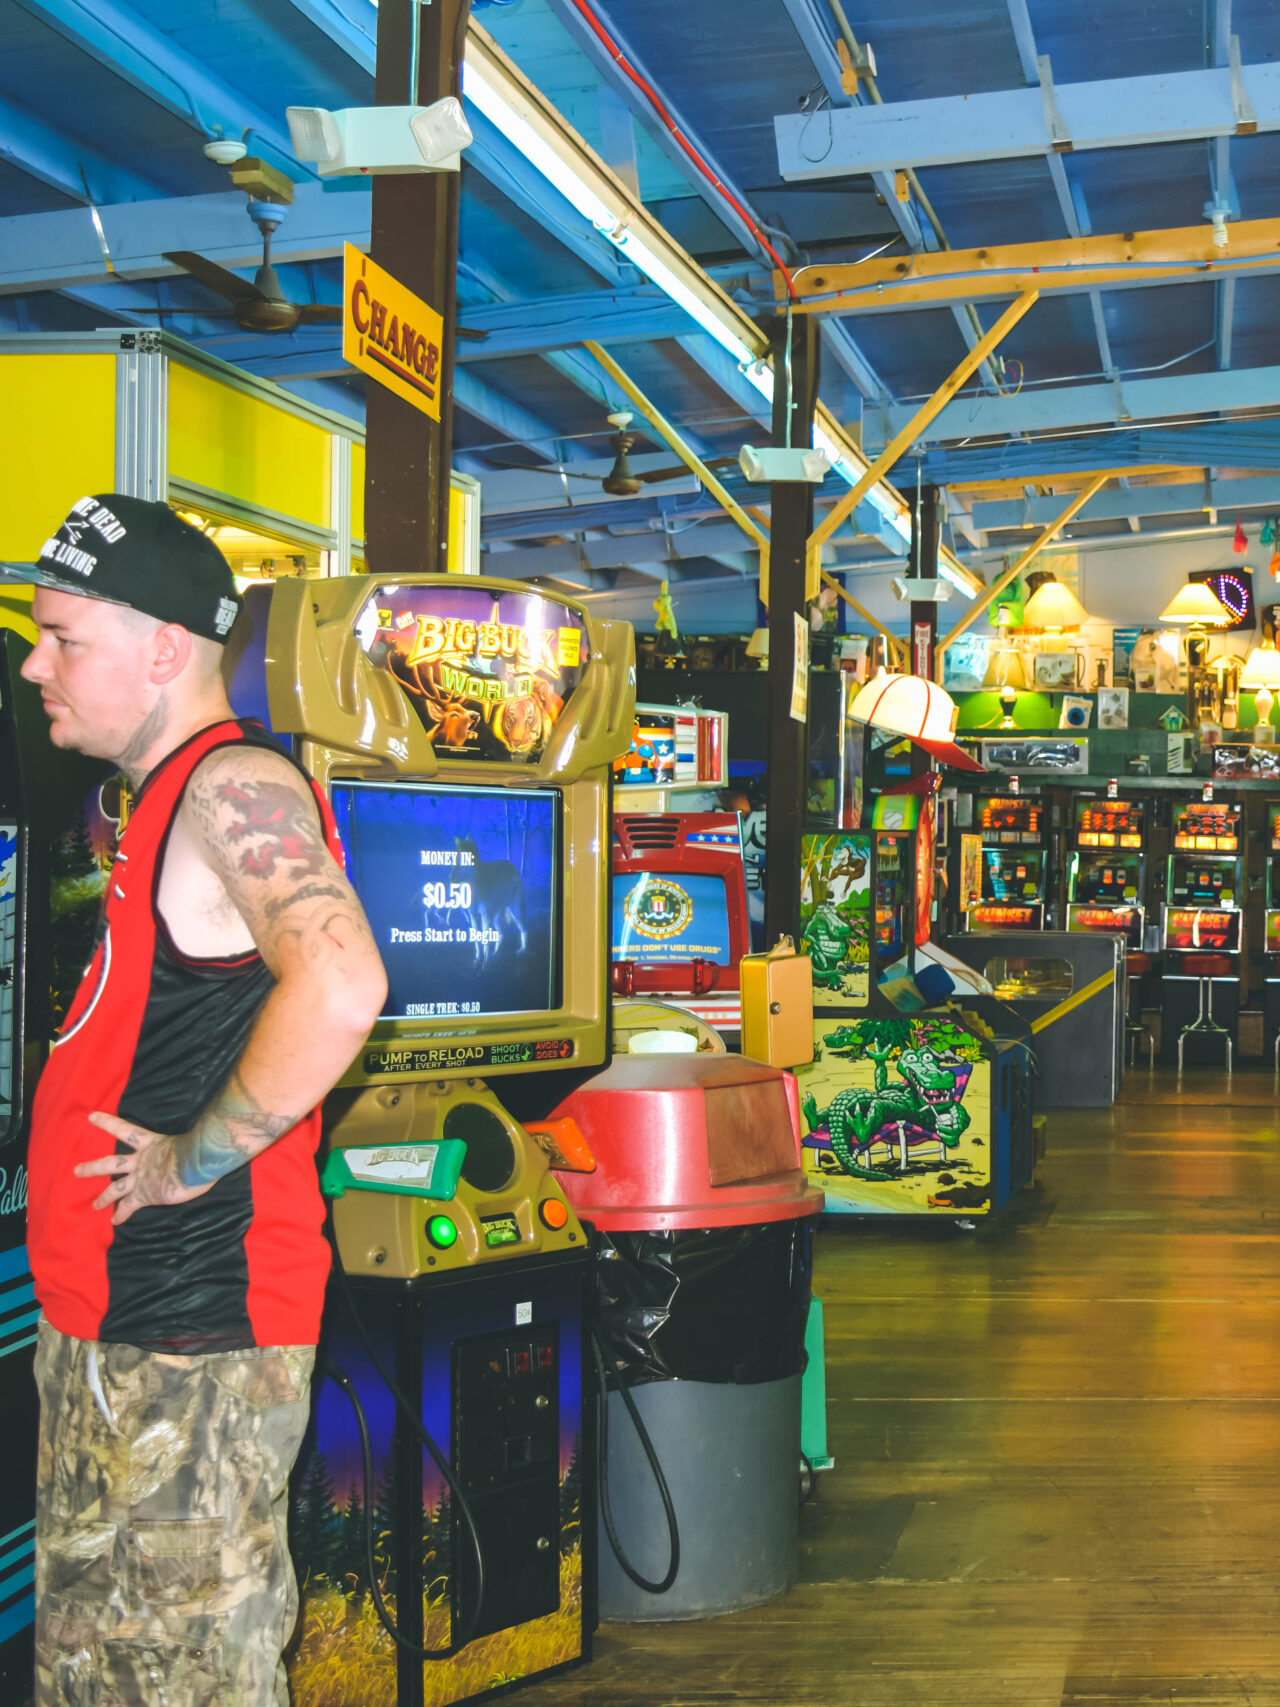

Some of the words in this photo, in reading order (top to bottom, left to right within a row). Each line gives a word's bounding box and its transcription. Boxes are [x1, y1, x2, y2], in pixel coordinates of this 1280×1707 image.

[351, 279, 439, 385] CHANGE
[89, 507, 126, 543] DEAD
[54, 543, 98, 577] LIVING
[406, 616, 476, 667] BIG
[479, 622, 560, 679] BUCK
[441, 663, 534, 700] WORLD
[421, 850, 458, 865] MONEY
[460, 851, 475, 866] IN:
[423, 882, 471, 909] $0.50
[974, 907, 1032, 923] SUNSET
[1076, 910, 1134, 926] SUNSET
[1172, 913, 1232, 929] SUNSET
[391, 928, 422, 943] Press
[424, 928, 453, 943] Start
[456, 929, 467, 943] to
[469, 928, 499, 944] Begin
[643, 943, 668, 952] DON'T
[670, 943, 687, 952] USE
[406, 1003, 435, 1016] SINGLE
[436, 1002, 460, 1014] TREK:
[462, 1001, 480, 1013] $0.50
[491, 1044, 521, 1054] SHOOT
[536, 1041, 560, 1050] AVOID
[369, 1052, 412, 1066] PUMP
[415, 1053, 427, 1062] TO
[429, 1046, 484, 1061] RELOAD
[491, 1053, 521, 1063] BUCKS
[536, 1050, 558, 1059] DOES
[384, 1063, 413, 1072] AFTER
[415, 1062, 442, 1070] EVERY
[446, 1059, 466, 1067] SHOT
